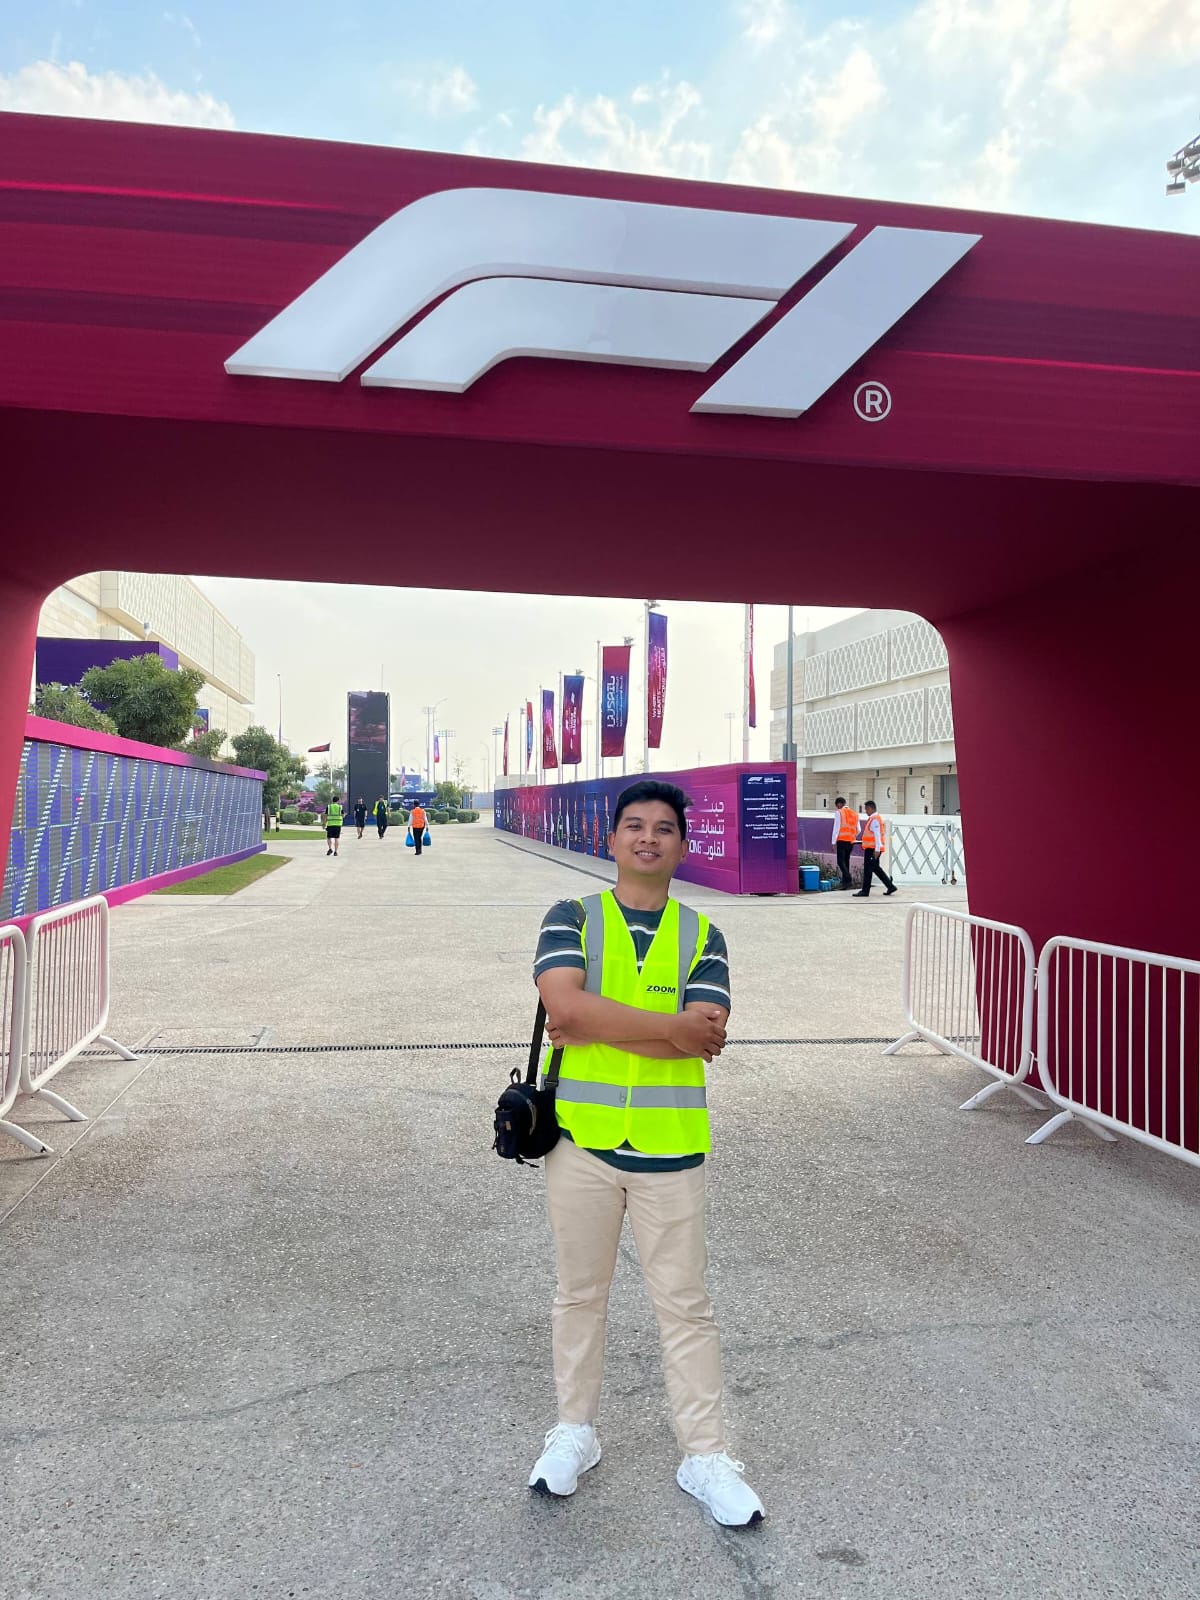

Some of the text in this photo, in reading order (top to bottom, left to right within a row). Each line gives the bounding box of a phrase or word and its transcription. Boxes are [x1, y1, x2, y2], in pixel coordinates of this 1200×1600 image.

[223, 186, 983, 419] F1
[606, 675, 616, 728] LUSAIL
[646, 985, 676, 994] ZOOM
